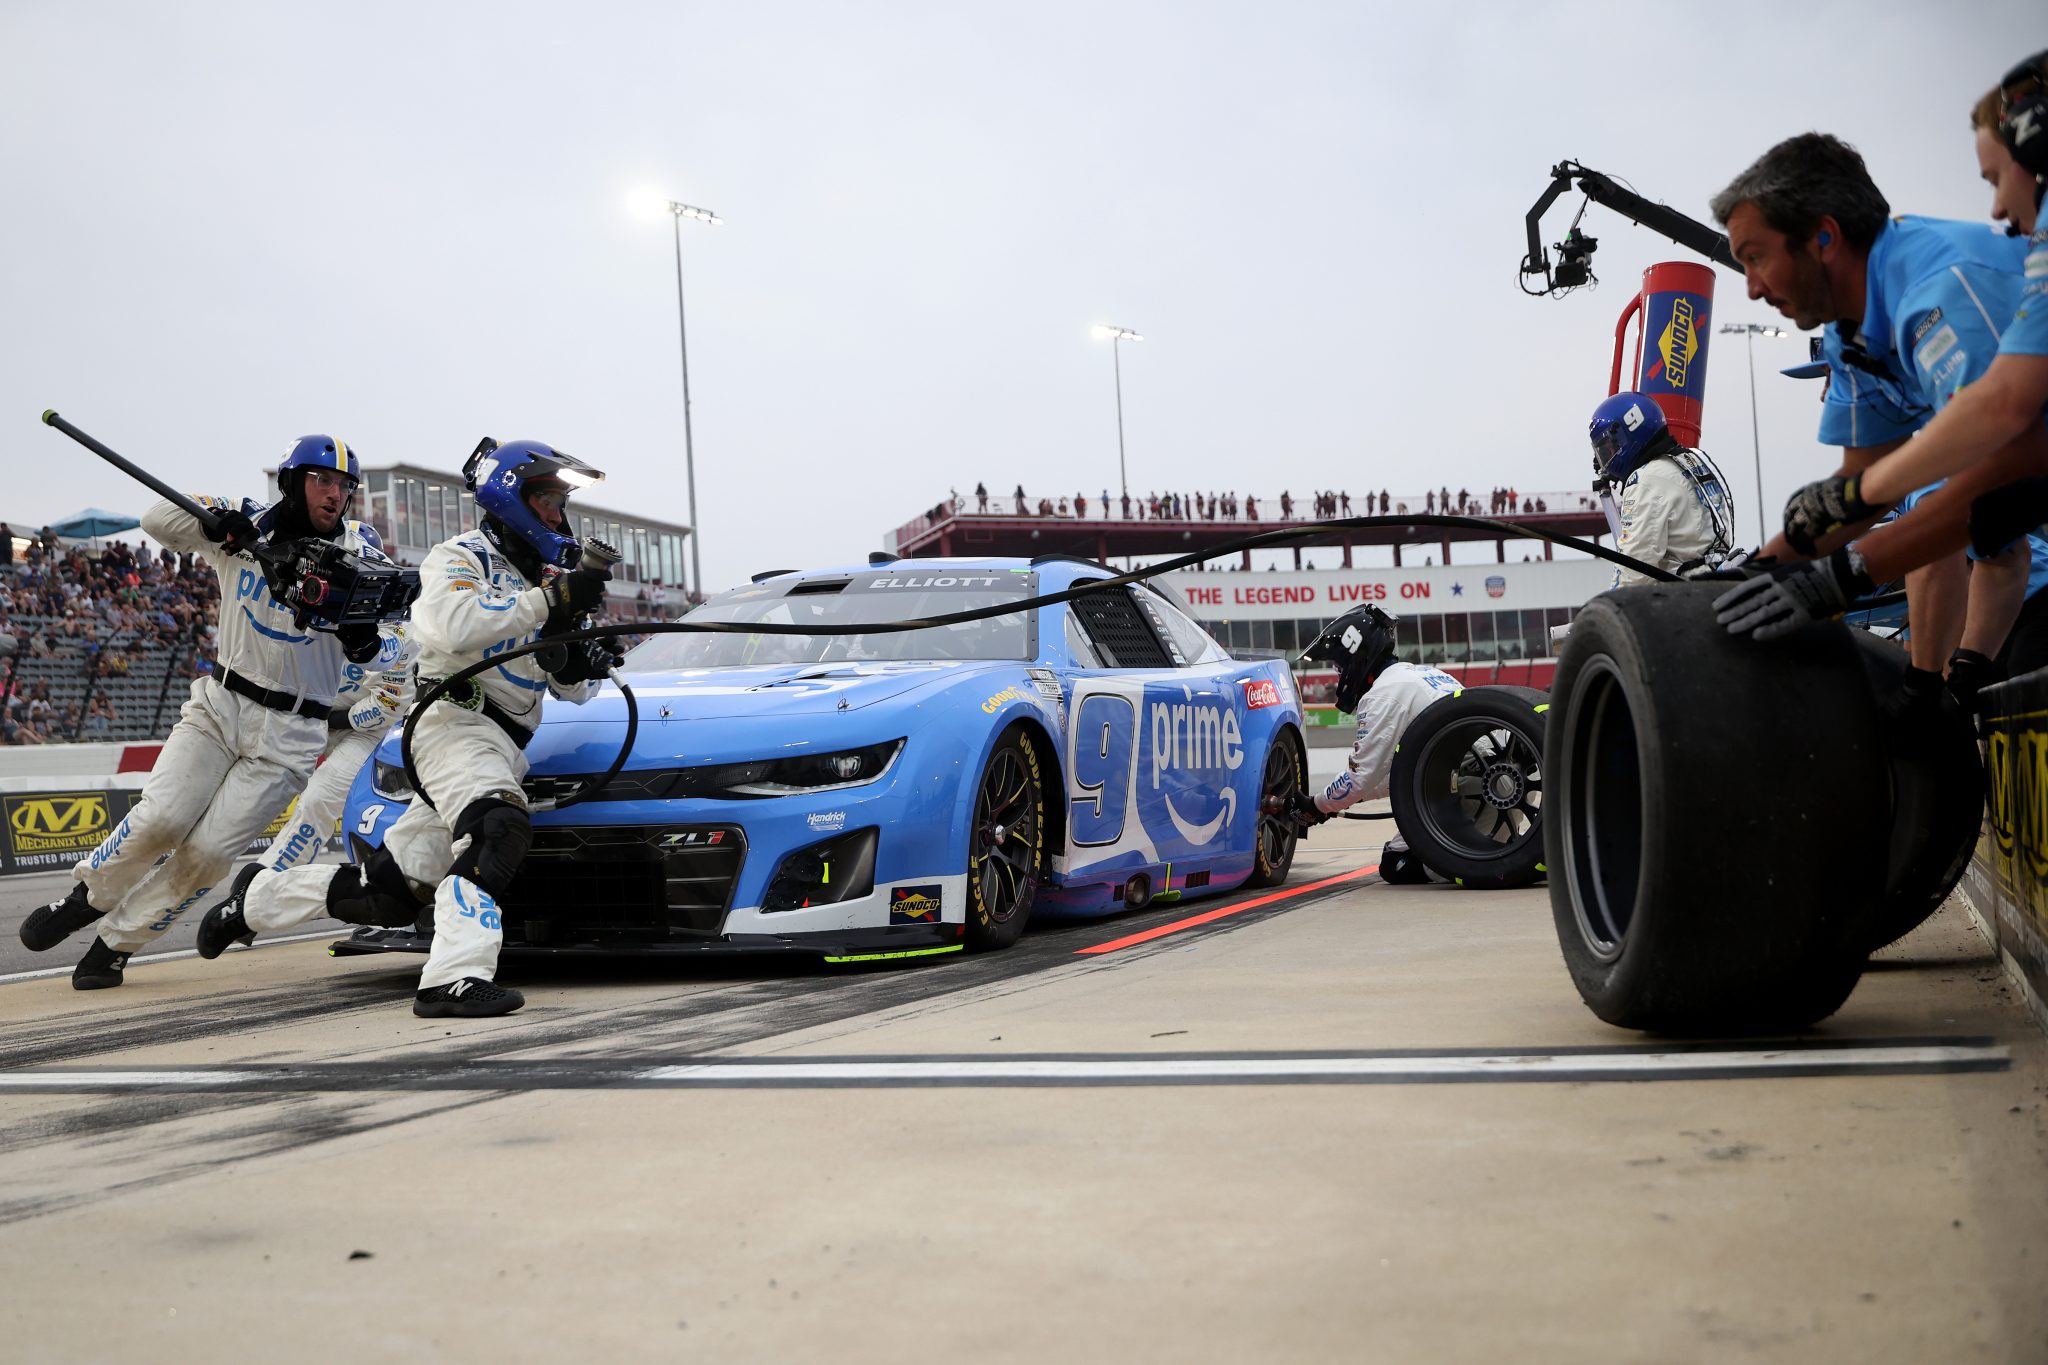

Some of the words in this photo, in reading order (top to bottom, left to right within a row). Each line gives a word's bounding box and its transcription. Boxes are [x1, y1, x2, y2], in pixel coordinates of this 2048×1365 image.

[1915, 307, 1941, 340] NASCAR
[1666, 299, 1693, 386] SUNOCO
[1624, 404, 1644, 430] 9
[869, 577, 1000, 589] ELLIOTT
[1186, 587, 1222, 605] THE
[1235, 586, 1315, 605] LEGEND
[1328, 584, 1387, 601] LIVES
[1401, 582, 1431, 598] ON
[1341, 624, 1363, 655] 9
[1247, 683, 1279, 707] Coca-Cola
[352, 707, 381, 727] prime
[1151, 684, 1244, 790] prime
[1070, 692, 1135, 848] 9
[1325, 771, 1350, 800] prime
[358, 804, 385, 835] 9
[807, 811, 846, 825] Hendrick
[16, 833, 76, 850] MECHANIX
[91, 817, 131, 870] prime
[658, 831, 725, 847] ZL1
[14, 852, 58, 867] TRUSTED
[60, 849, 92, 861] PROTE
[971, 855, 989, 926] EAGLE
[893, 900, 938, 911] SUNOCO
[448, 980, 473, 997] N
